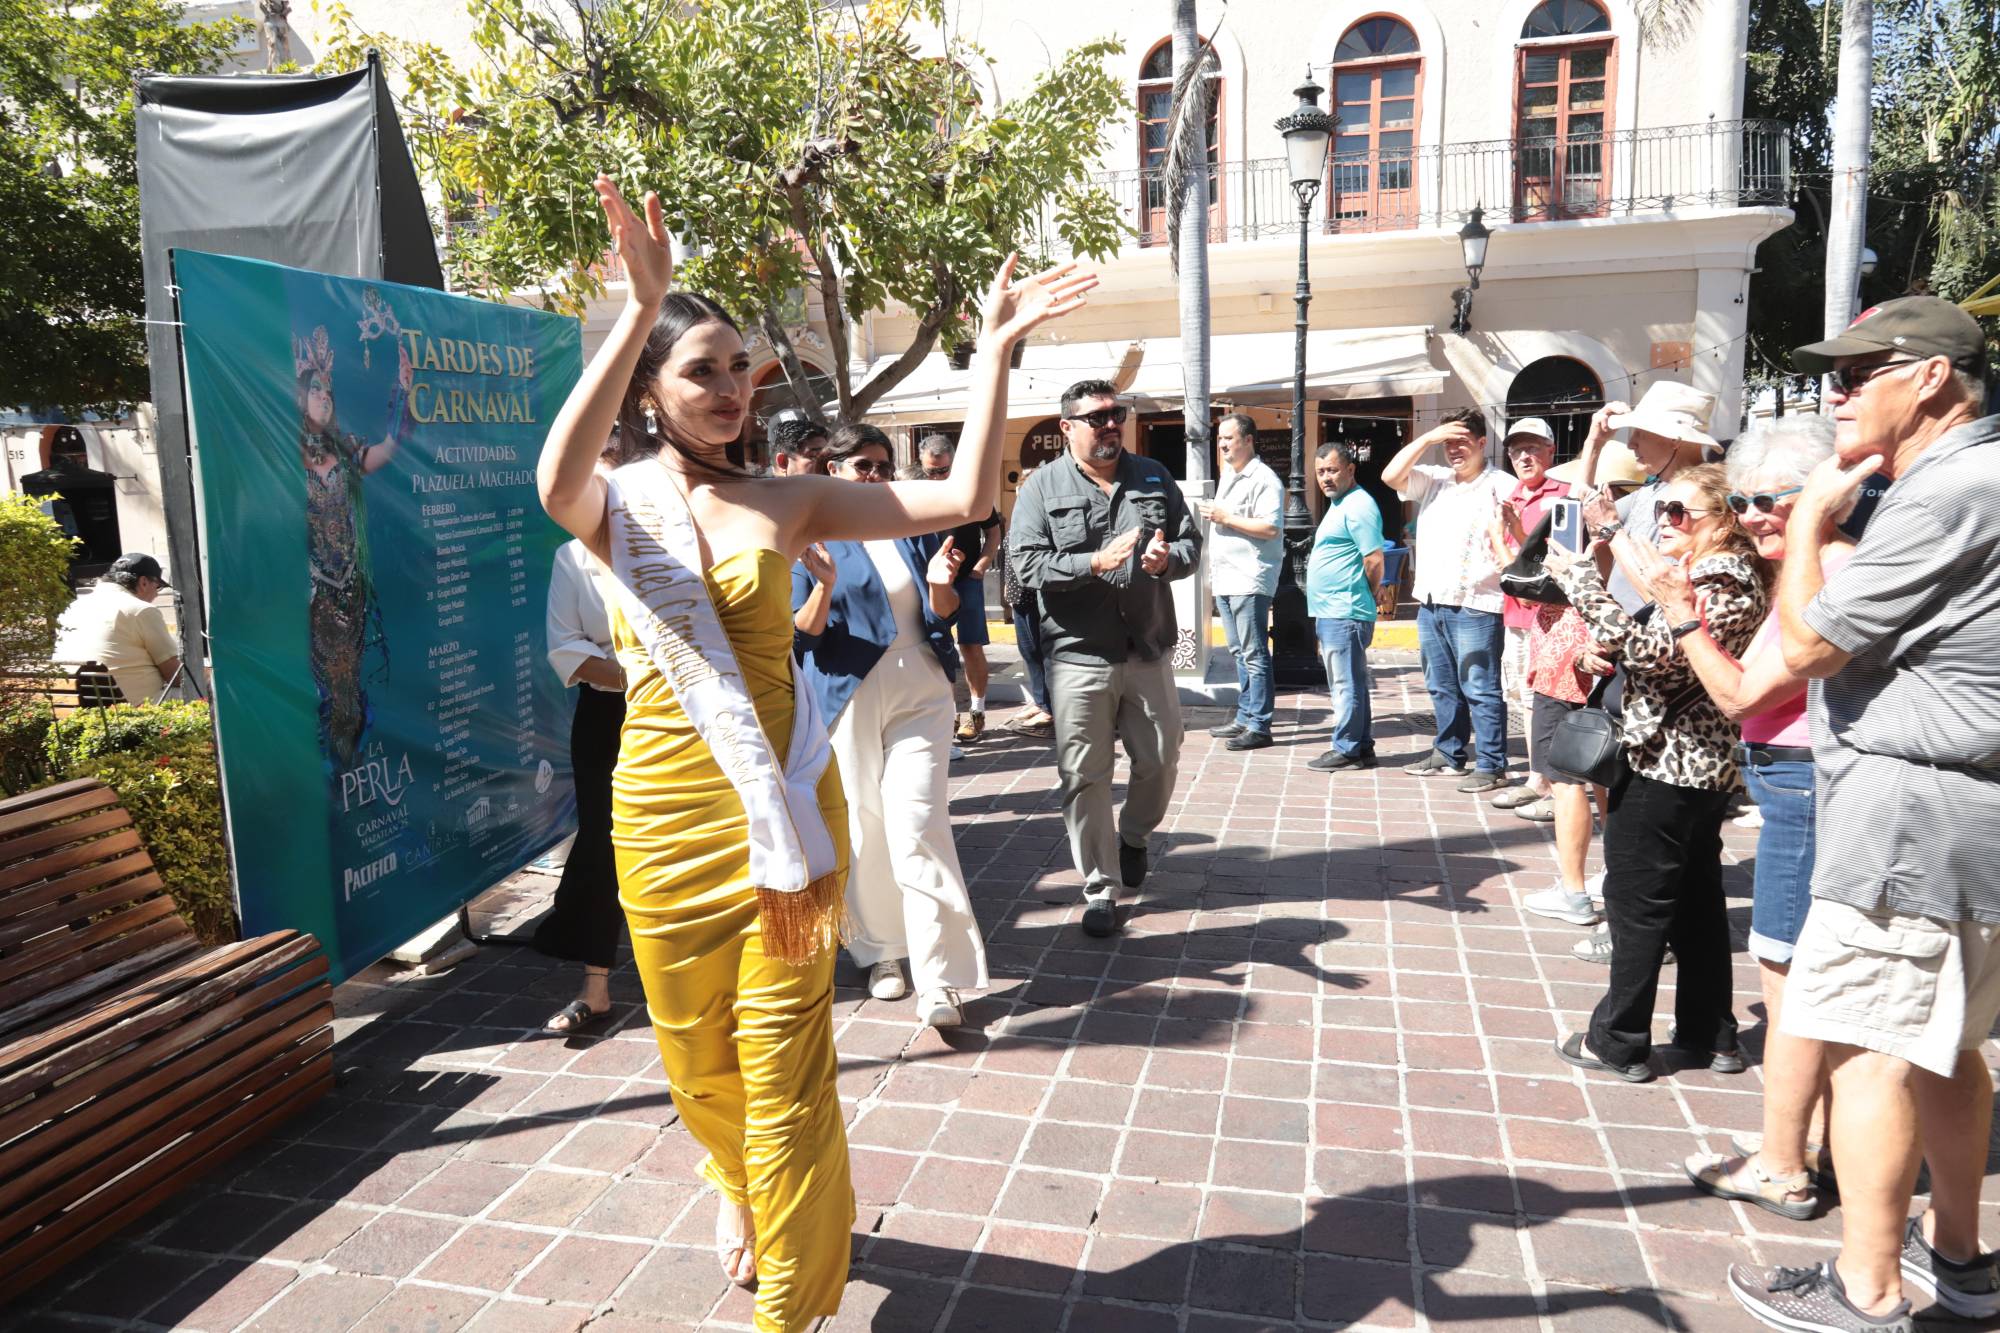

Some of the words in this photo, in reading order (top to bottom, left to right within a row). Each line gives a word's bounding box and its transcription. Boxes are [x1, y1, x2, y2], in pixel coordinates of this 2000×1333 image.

[505, 345, 534, 378] DE
[408, 383, 536, 423] CARNAVAL
[8, 450, 24, 460] 515
[435, 445, 517, 464] ACTIVIDADES
[412, 473, 475, 493] PLAZUELA
[478, 469, 538, 489] MACHADO
[422, 503, 456, 516] FEBRERO
[630, 563, 698, 597] del
[428, 641, 459, 657] MARZO
[368, 740, 384, 758] LA
[340, 752, 416, 814] PERLA
[357, 803, 409, 837] CARNAVAL
[343, 851, 397, 904] PACIFICO
